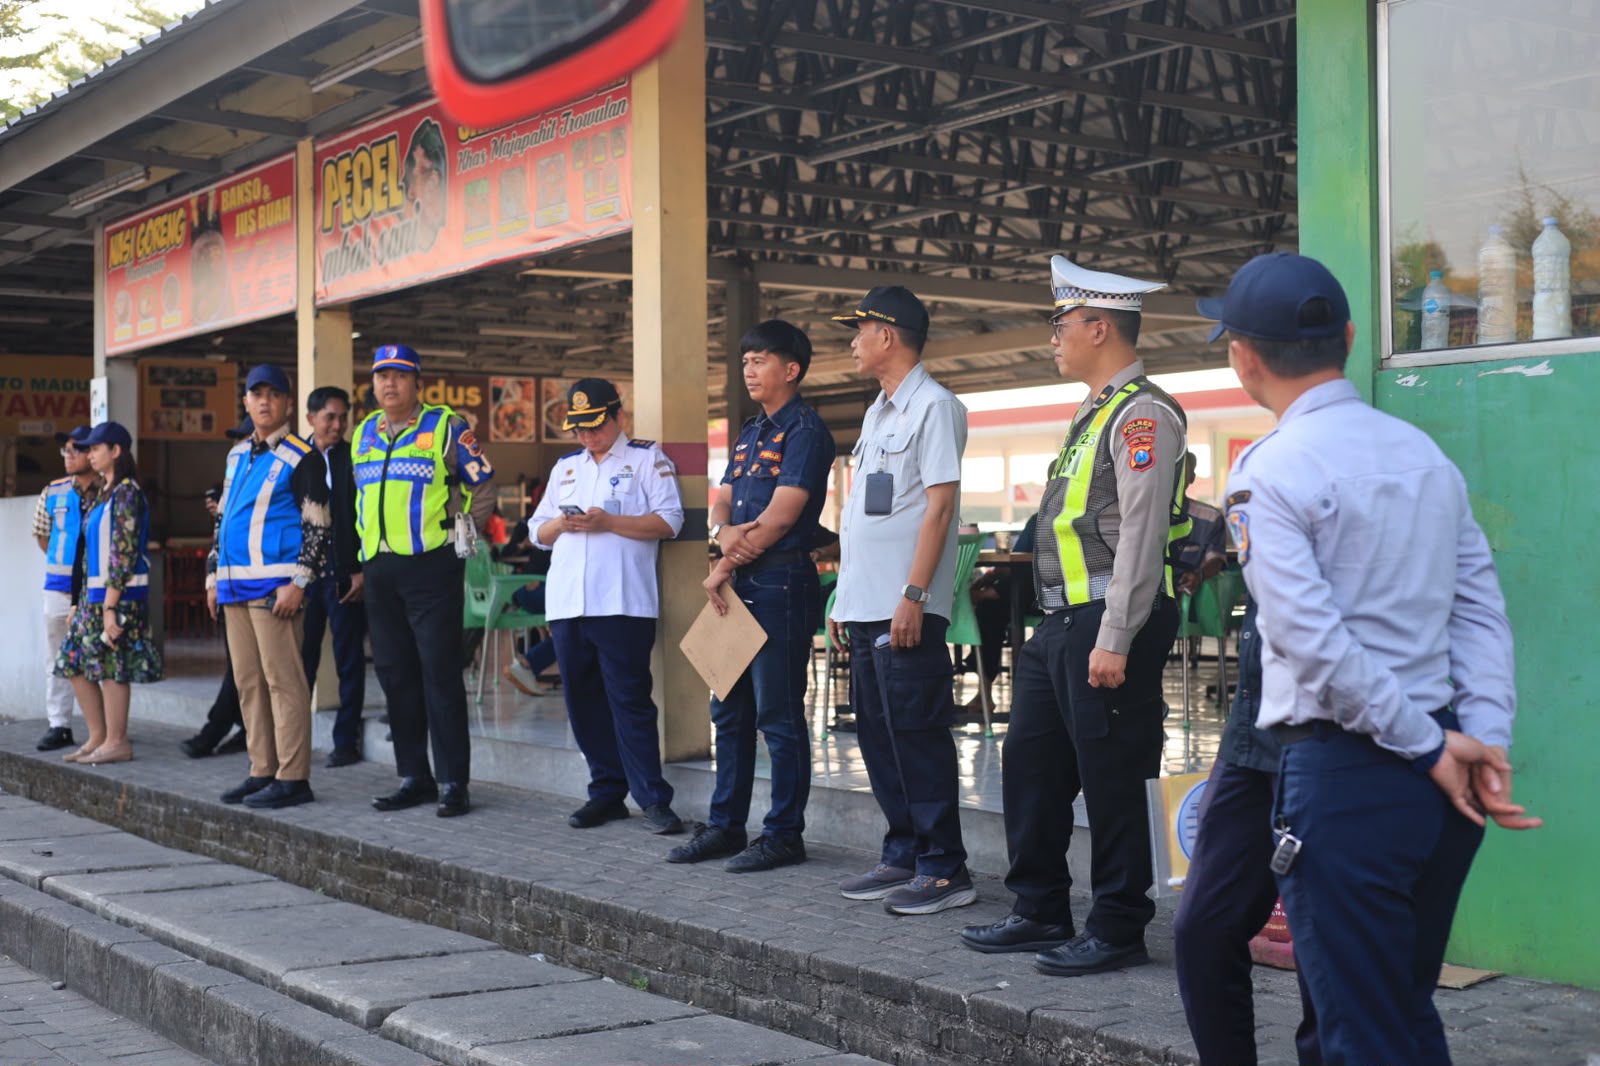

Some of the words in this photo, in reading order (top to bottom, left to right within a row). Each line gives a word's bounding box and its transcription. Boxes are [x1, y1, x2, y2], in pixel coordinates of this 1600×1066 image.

[457, 149, 486, 174] Khas
[491, 119, 557, 163] Majapahit
[560, 96, 627, 136] Trowulan
[221, 176, 261, 213] BAKSO
[323, 135, 403, 233] PECEL
[136, 207, 186, 259] GORENG
[235, 208, 257, 239] JUS
[258, 195, 291, 230] BUAH
[322, 222, 372, 284] mbok
[377, 200, 422, 266] sani
[1123, 419, 1153, 434] POLRES
